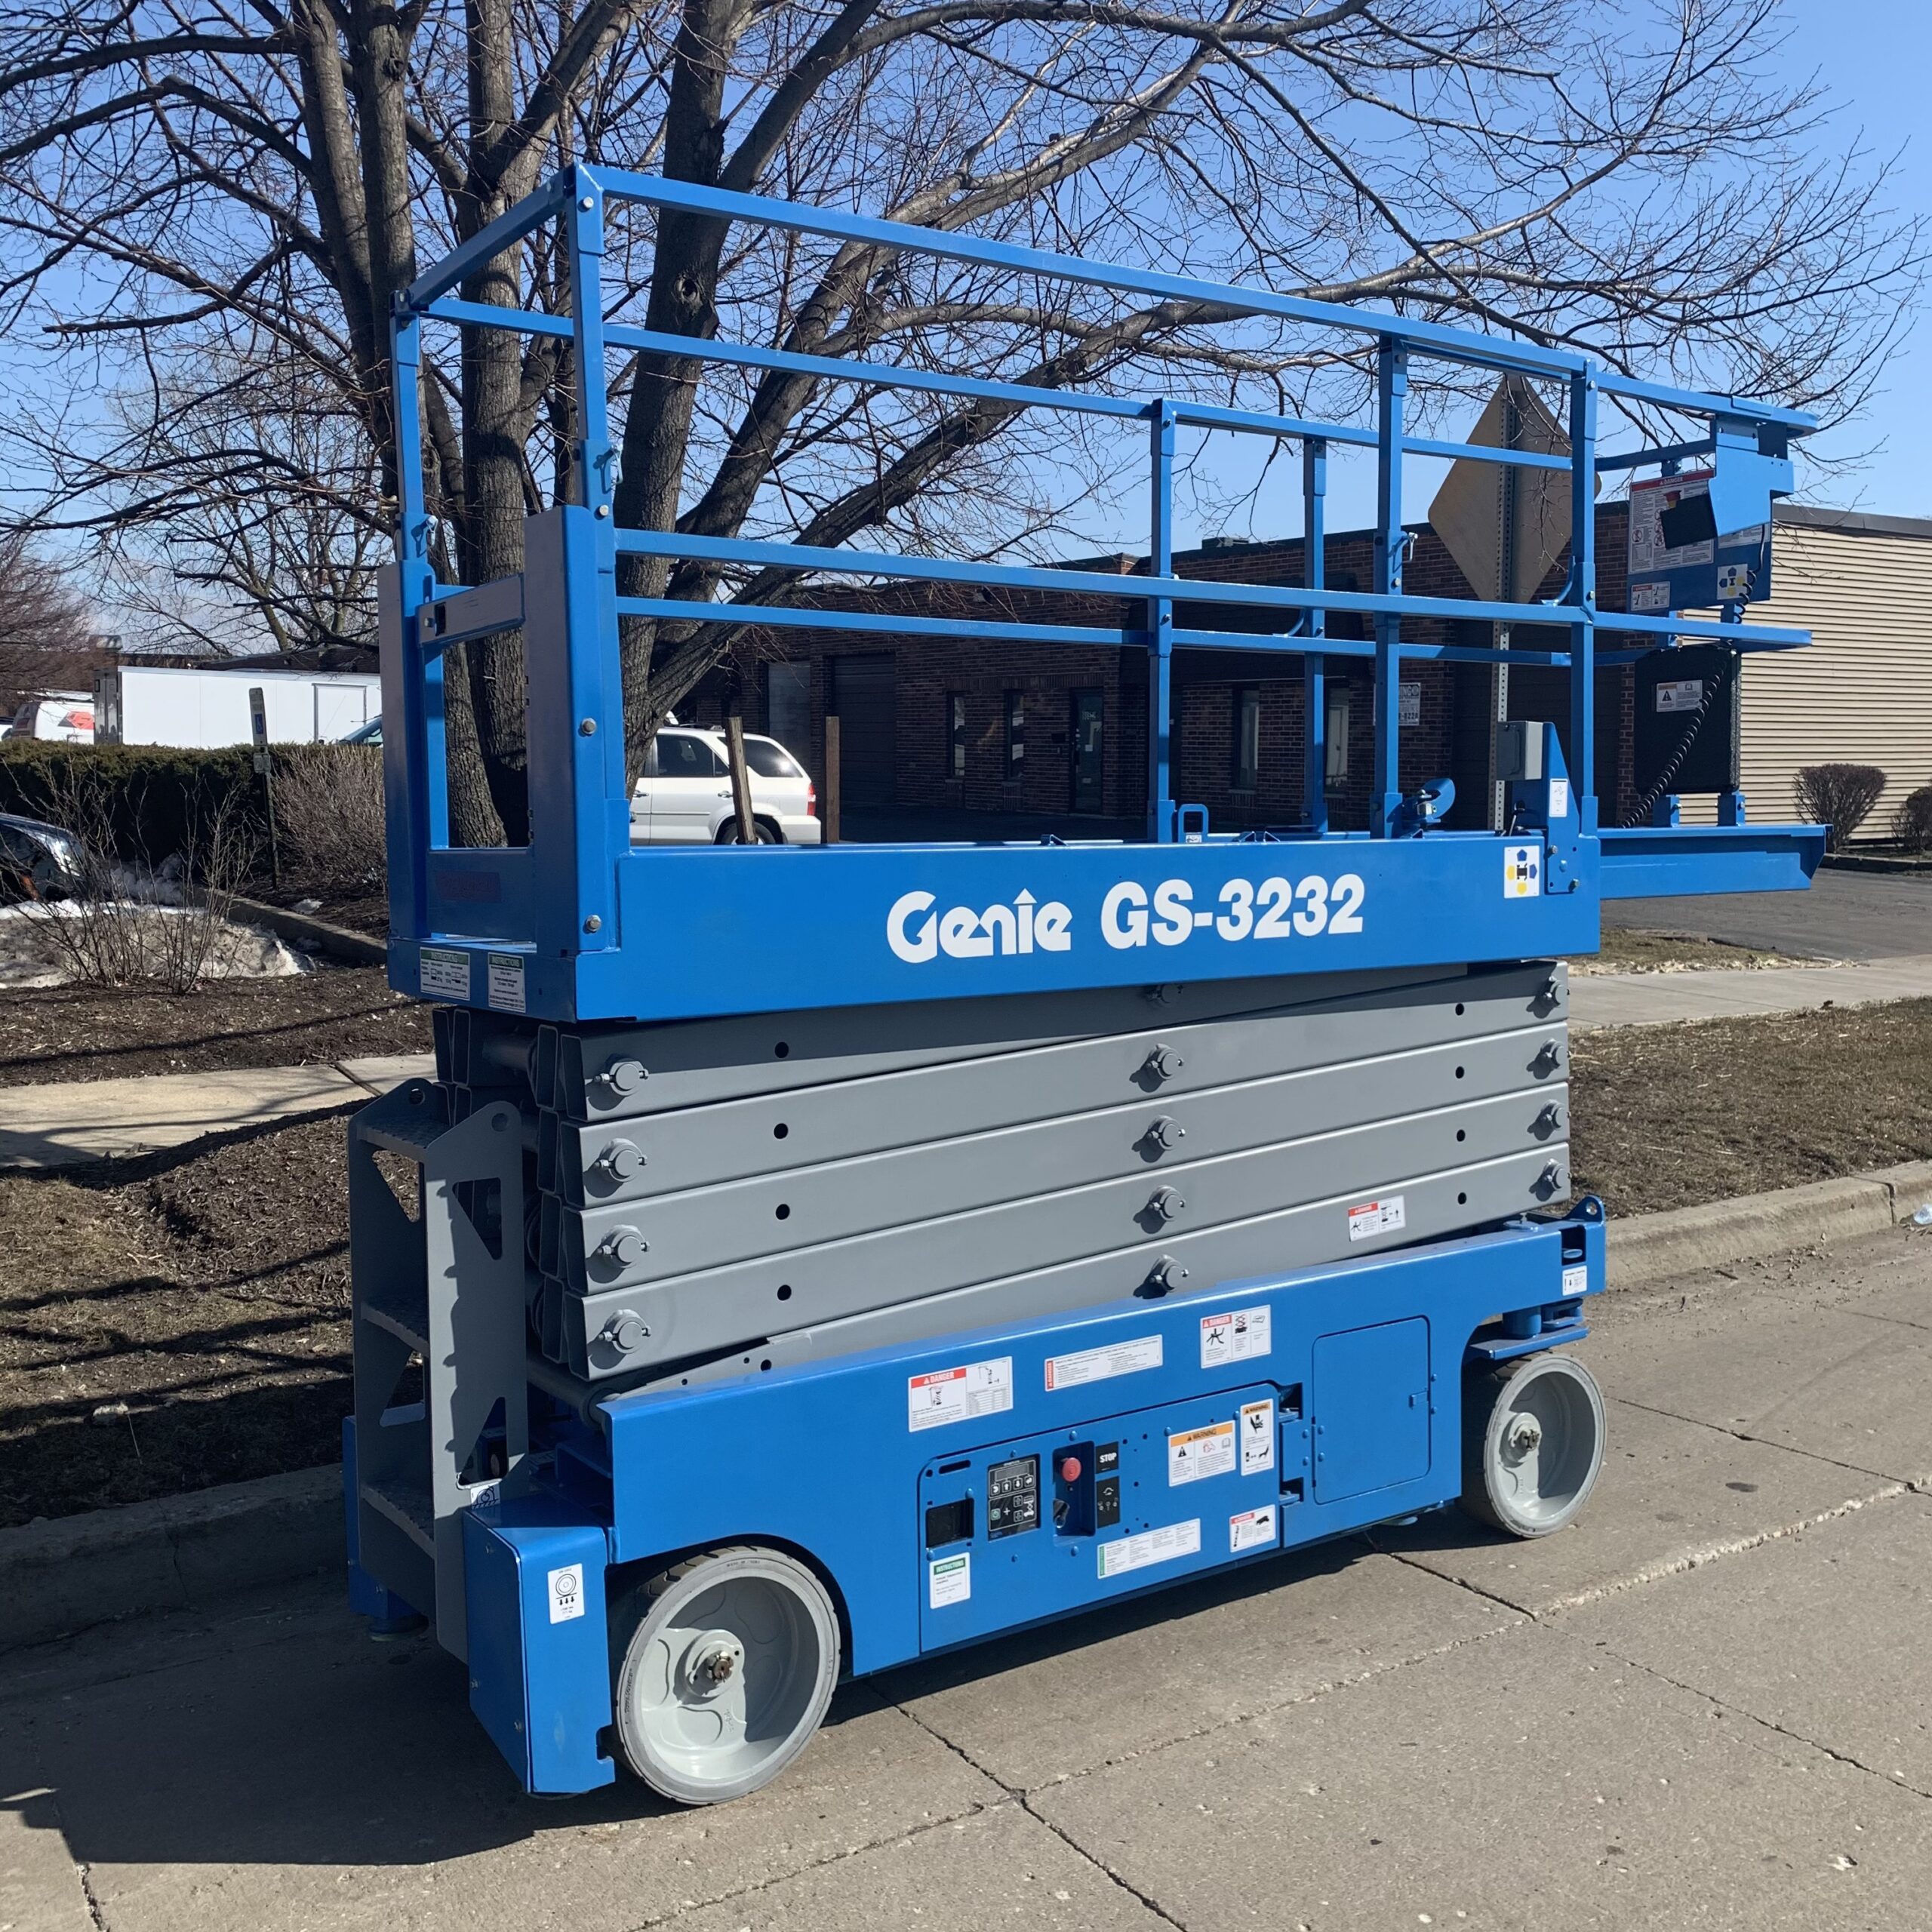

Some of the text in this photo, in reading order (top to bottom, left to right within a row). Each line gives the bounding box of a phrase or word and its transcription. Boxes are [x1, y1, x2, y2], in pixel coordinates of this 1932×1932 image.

[887, 873, 1364, 964] Genie GS-3232
[930, 1371, 955, 1383] DANGER
[1192, 1428, 1217, 1440] WARNING
[1099, 1451, 1118, 1463] STOP
